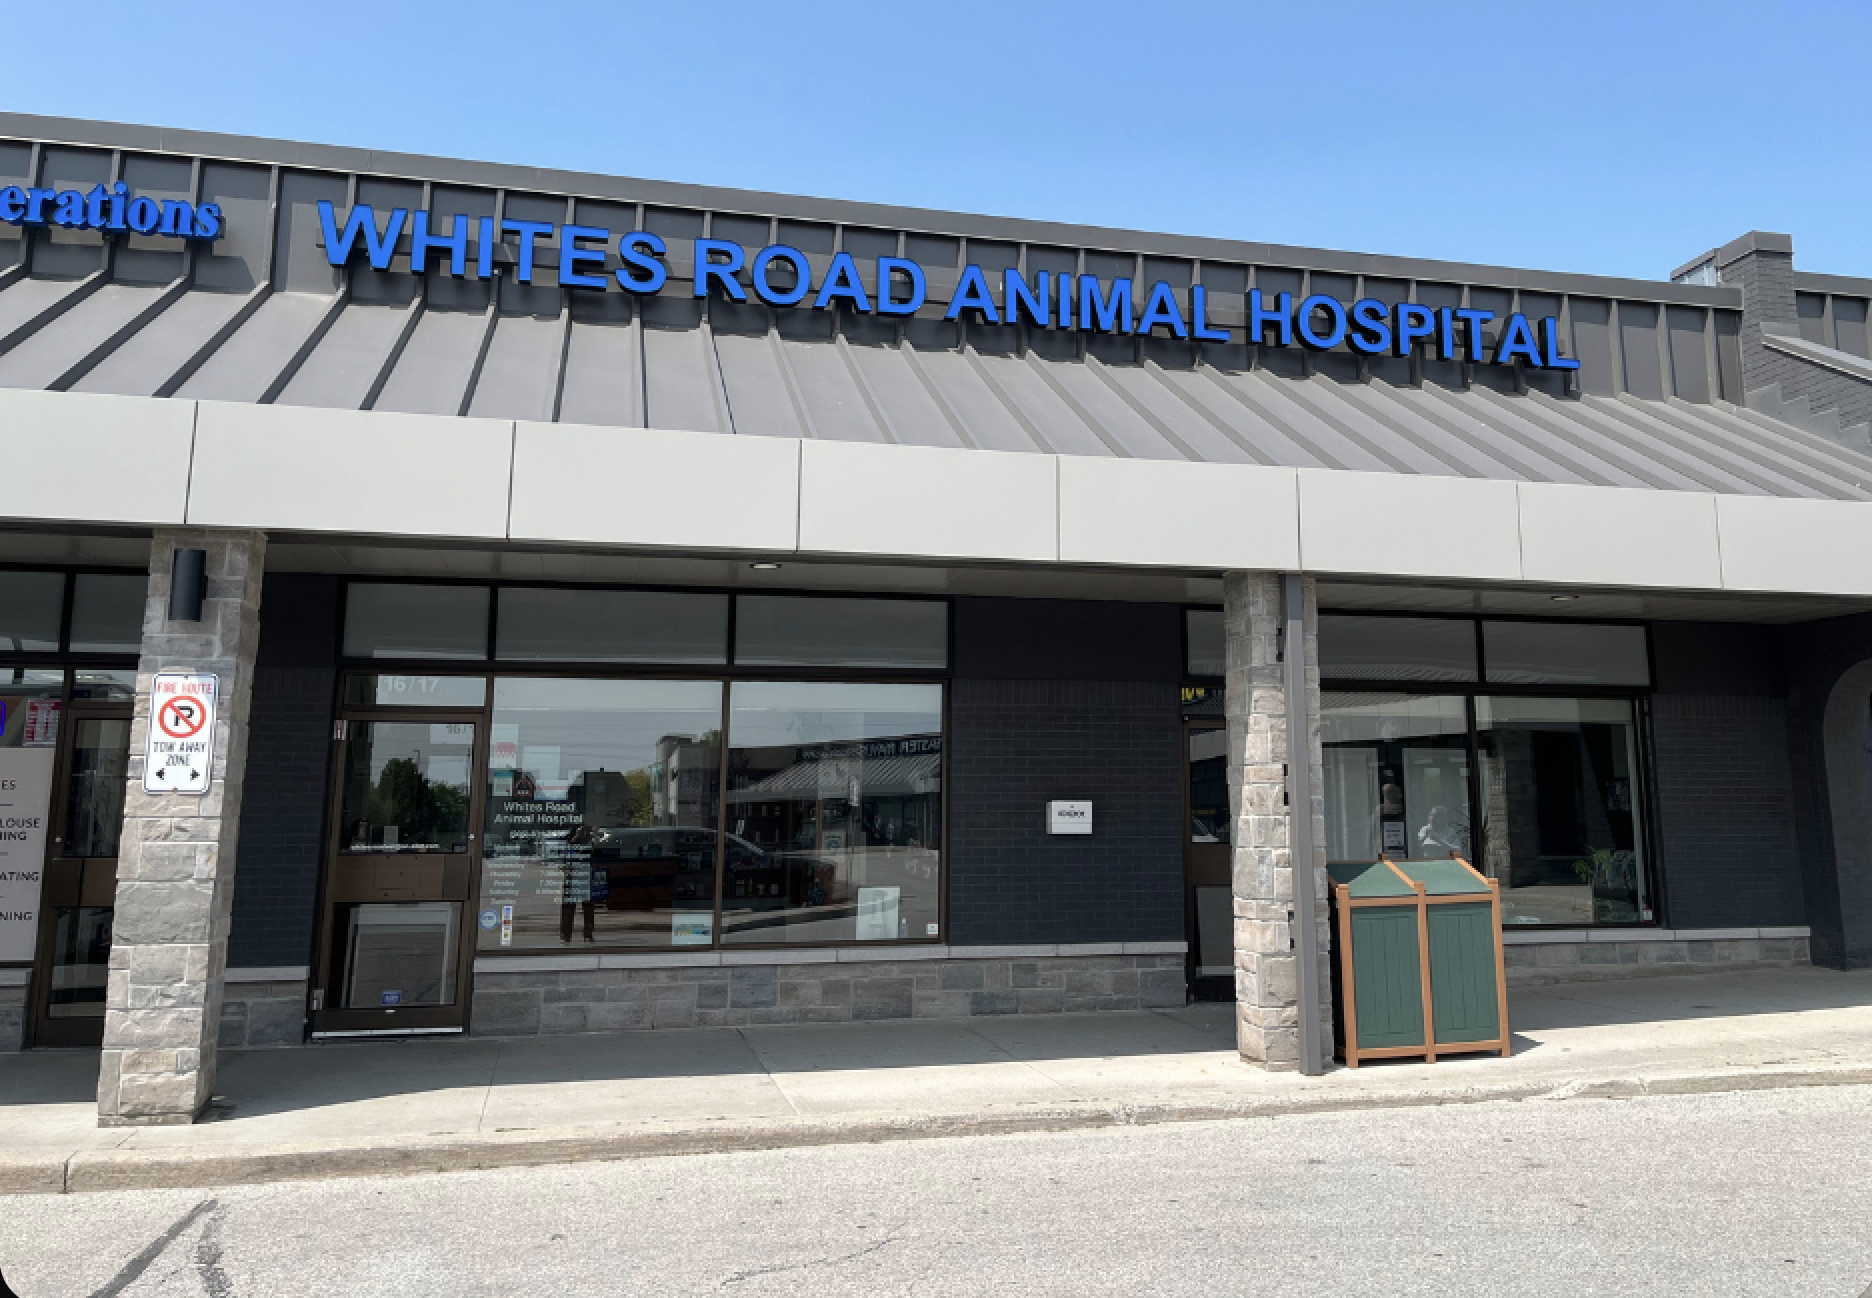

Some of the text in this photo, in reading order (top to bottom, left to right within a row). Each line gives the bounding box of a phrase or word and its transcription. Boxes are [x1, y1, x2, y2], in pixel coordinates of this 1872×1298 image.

[316, 199, 1582, 371] WHITES ROAD ANIMAL HOSPITAL
[156, 682, 176, 695] FIRE
[382, 676, 440, 693] 16/17
[153, 741, 207, 753] TOW AWAY
[165, 754, 190, 767] ZONE
[503, 801, 577, 813] Whites Road
[493, 813, 583, 827] Animal Hospital
